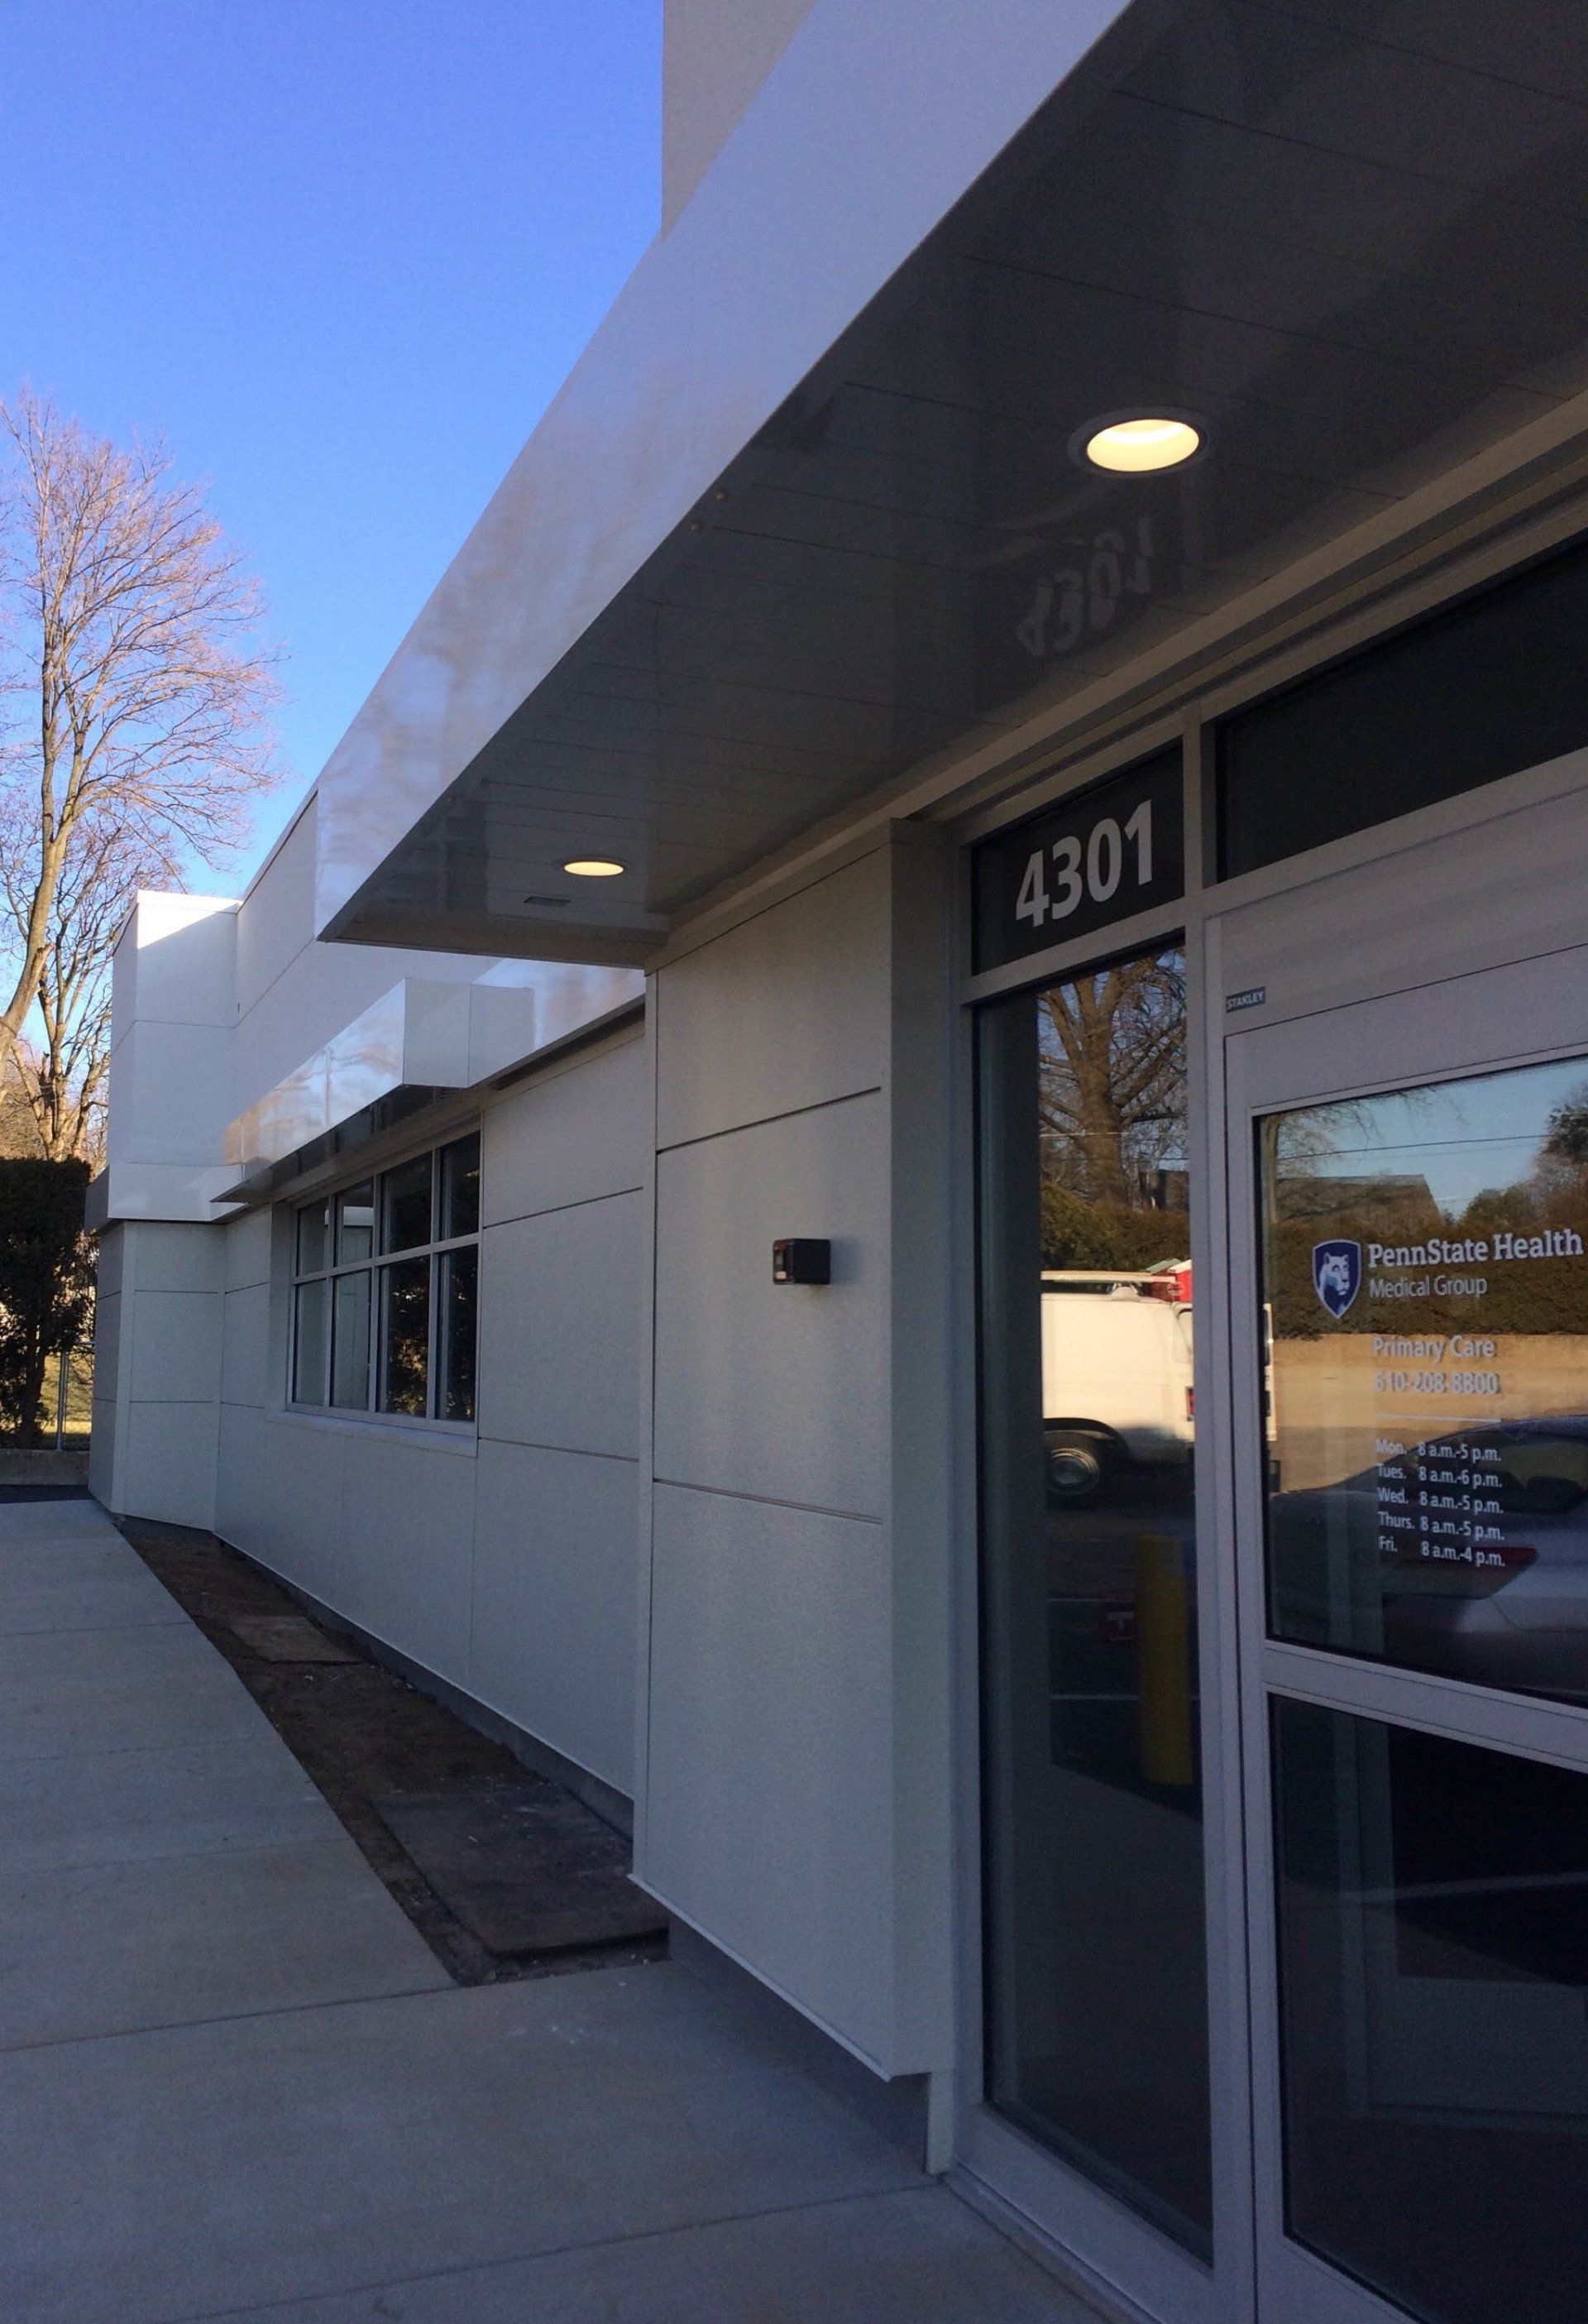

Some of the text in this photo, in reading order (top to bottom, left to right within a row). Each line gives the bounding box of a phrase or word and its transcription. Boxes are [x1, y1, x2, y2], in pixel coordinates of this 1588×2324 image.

[1015, 798, 1153, 927] 4301
[1368, 1229, 1584, 1268] PennState Health
[1369, 1275, 1488, 1299] Medical Group
[1372, 1335, 1496, 1363] Primary Care
[1375, 1372, 1500, 1394] 610-208-8800
[1375, 1440, 1407, 1454] Mon.
[1472, 1448, 1502, 1464] p.m.
[1377, 1463, 1407, 1479] Tues.
[1473, 1473, 1503, 1489] p.m.
[1377, 1488, 1409, 1504] Wed.
[1474, 1499, 1504, 1516] p.m.
[1377, 1512, 1416, 1530] Thurs.
[1475, 1525, 1505, 1541] p.m.
[1378, 1536, 1399, 1552] Fri.
[1476, 1550, 1505, 1567] p.m.
